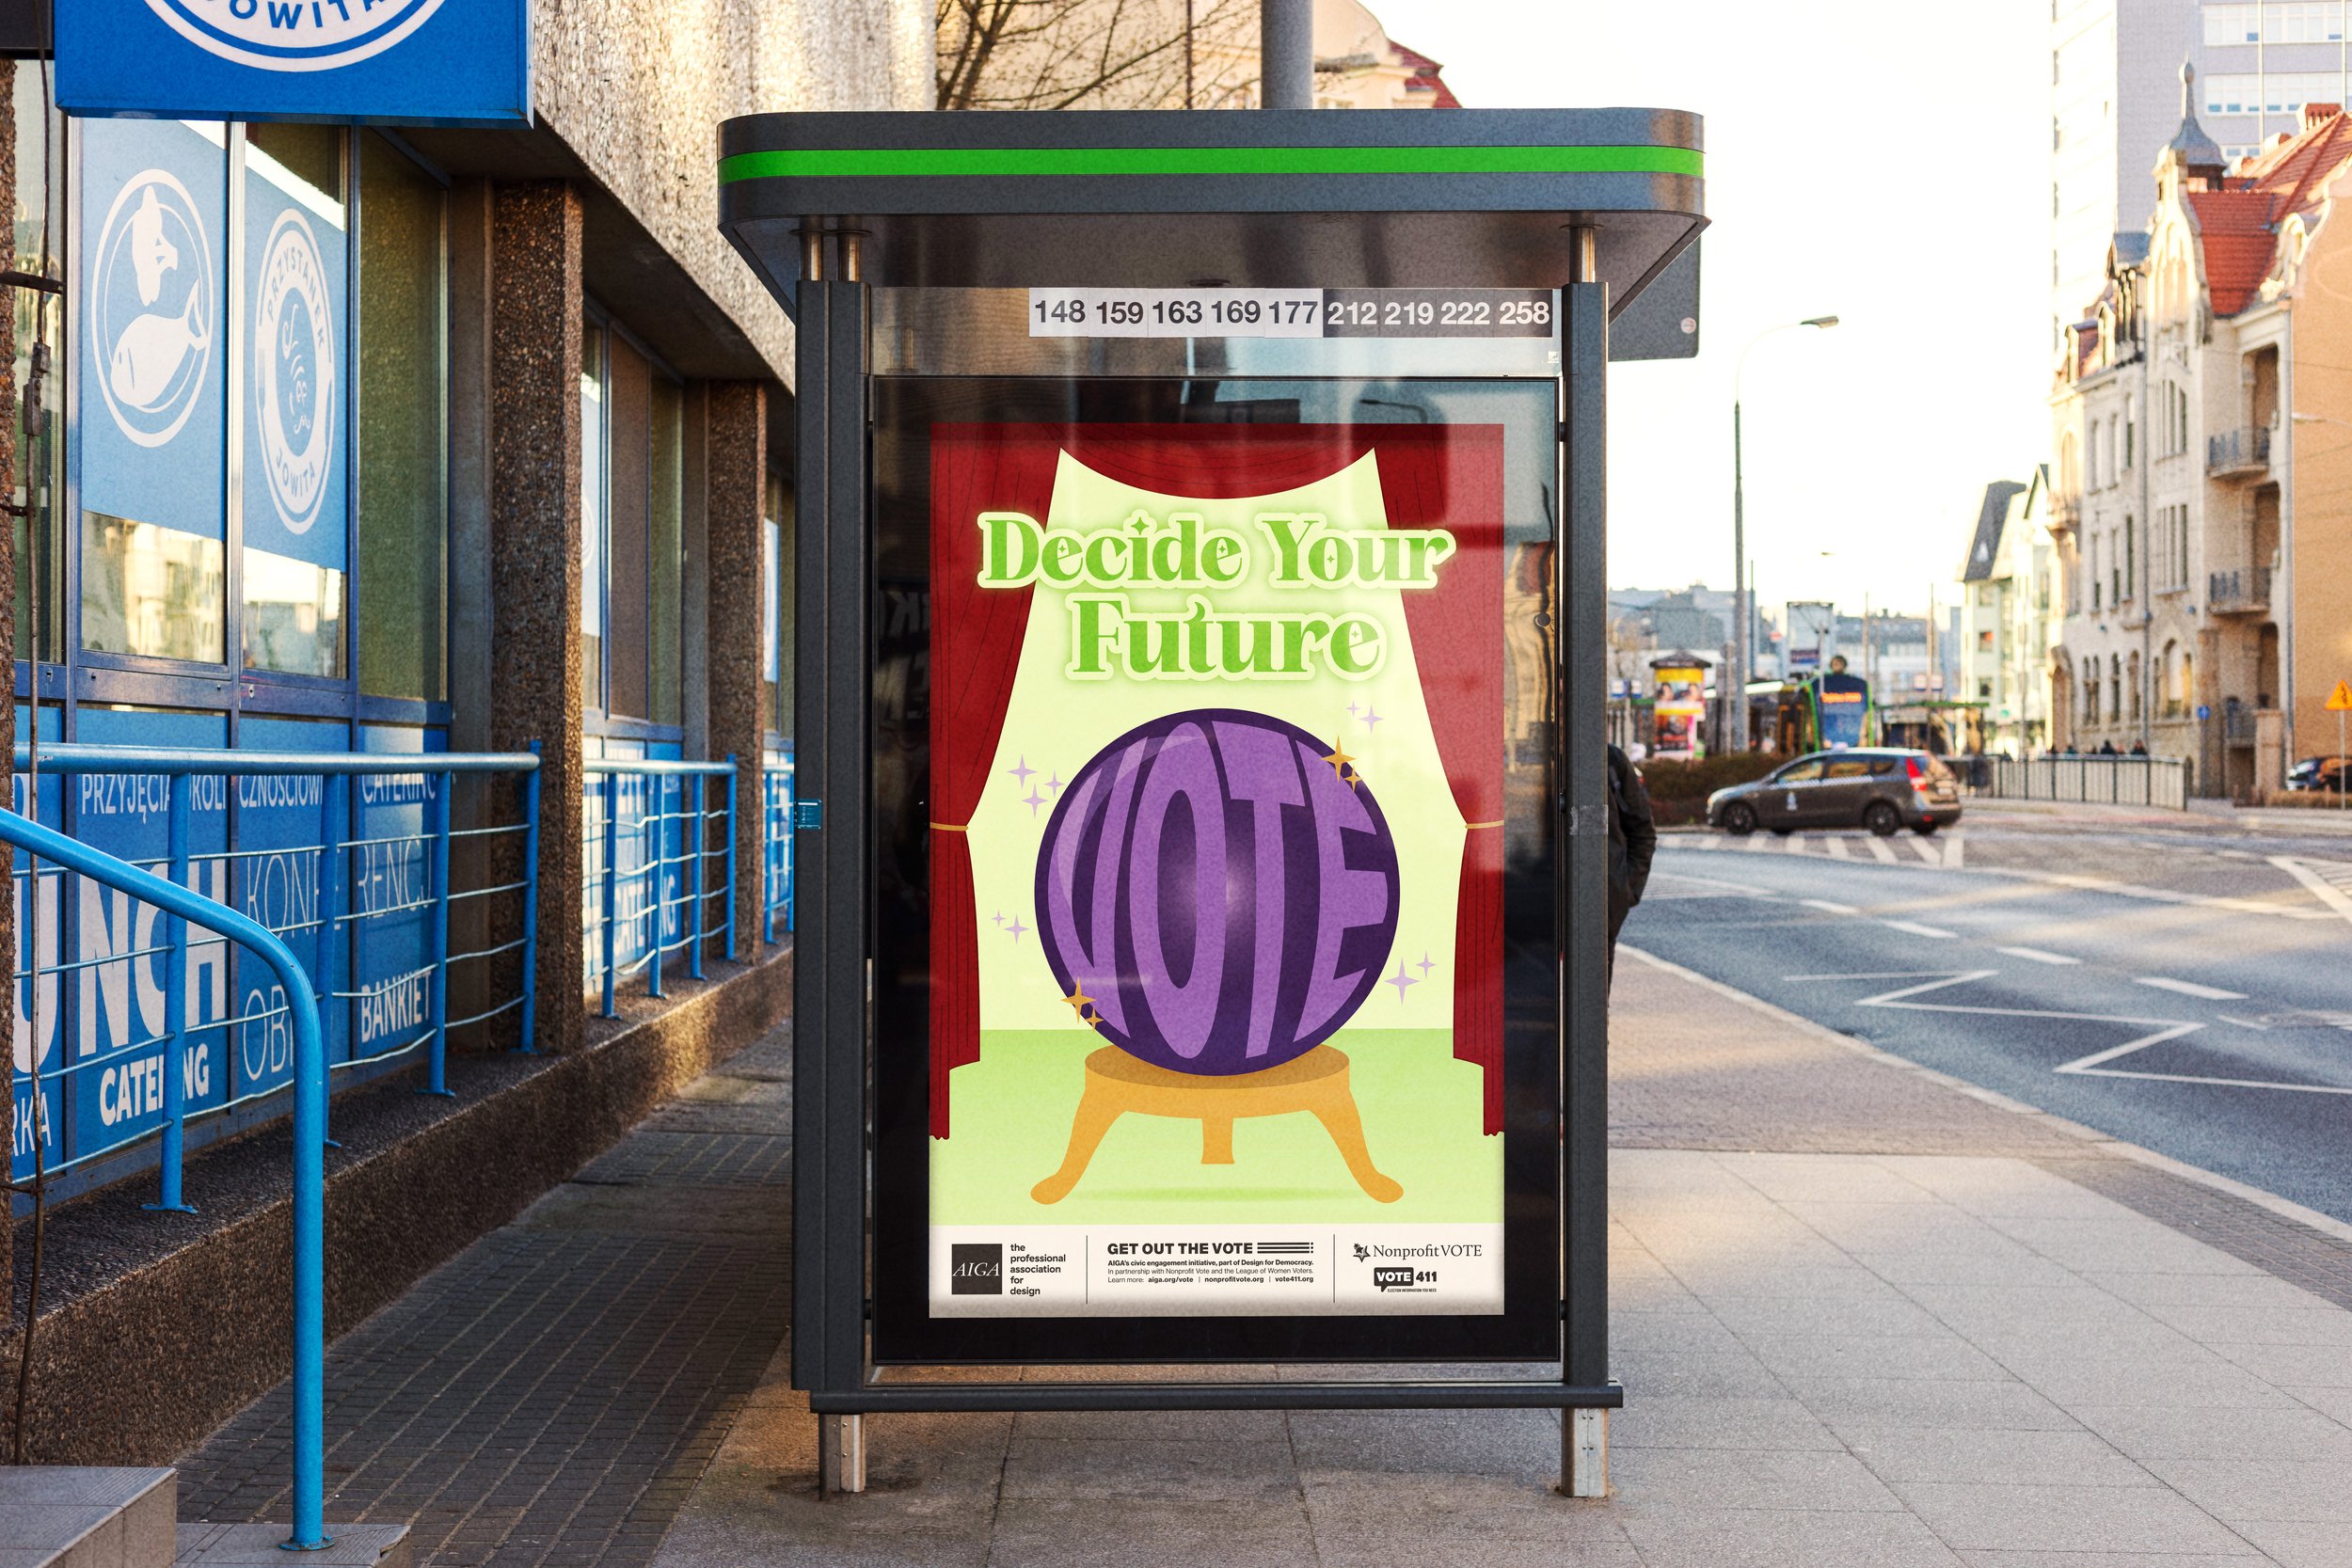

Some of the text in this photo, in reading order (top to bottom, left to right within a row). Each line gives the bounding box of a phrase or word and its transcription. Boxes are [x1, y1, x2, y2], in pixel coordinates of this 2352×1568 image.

[207, 0, 384, 30] OWIT
[267, 245, 325, 349] PRZYSTANEK
[1035, 299, 1550, 325] 148 159 163 169 177 212 219 222 258
[276, 447, 316, 498] JOWITA
[983, 516, 1450, 582] Decide Your
[1073, 599, 1380, 674] Future
[1048, 721, 1389, 1059] VOTE
[360, 970, 433, 1043] BANKIET
[100, 1042, 210, 1127] CATENG
[1009, 1243, 1026, 1252] the
[1106, 1243, 1253, 1255] GET OUT THE VOTE
[1009, 1254, 1067, 1264] professional
[1147, 1259, 1187, 1268] engagement
[1188, 1259, 1217, 1267] initiative,
[1241, 1259, 1263, 1267] Design
[1275, 1259, 1314, 1267] Democracy.
[952, 1262, 1000, 1276] AIGA
[1009, 1264, 1061, 1274] association
[1235, 1267, 1259, 1275] League
[1009, 1275, 1025, 1284] for
[1148, 1275, 1194, 1285] aiga.org/vote
[1204, 1275, 1264, 1284] nonprofitvote.org
[1274, 1275, 1314, 1284] vote411.org
[1375, 1271, 1438, 1282] VOTE 411
[1009, 1286, 1041, 1297] design
